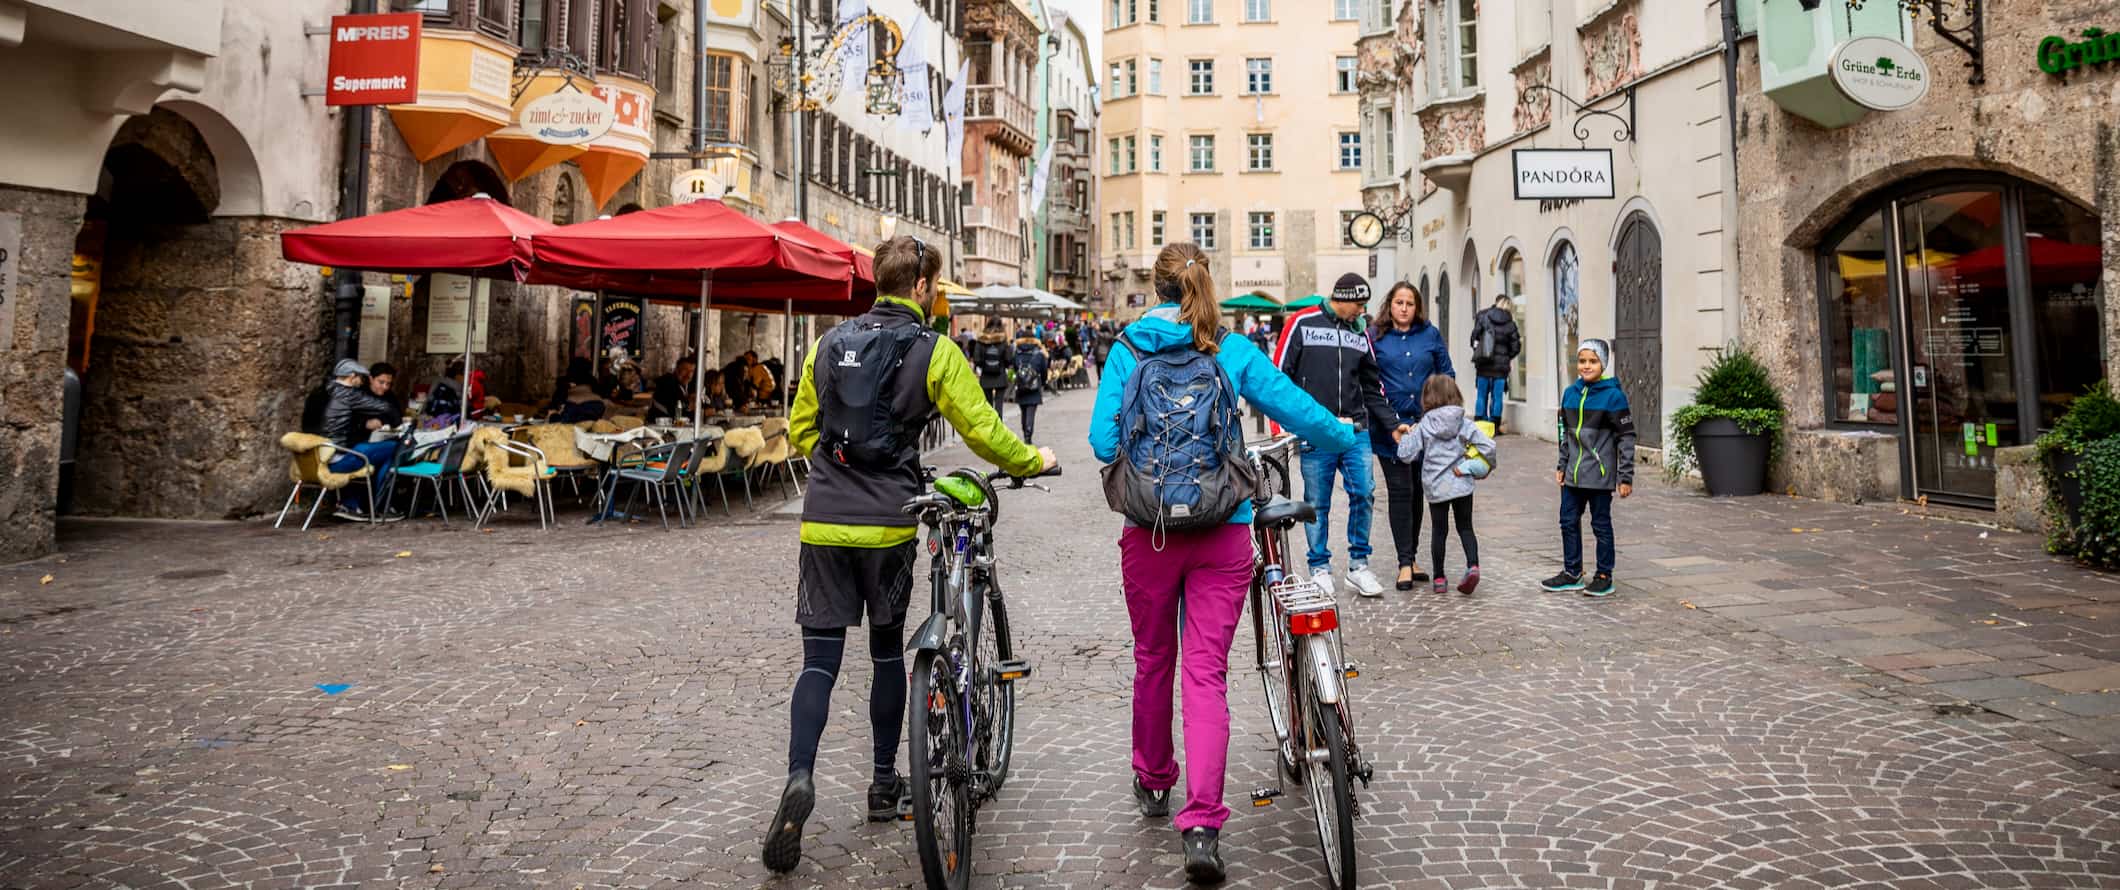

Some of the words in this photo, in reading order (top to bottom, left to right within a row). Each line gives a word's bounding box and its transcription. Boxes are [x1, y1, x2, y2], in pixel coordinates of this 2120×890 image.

[337, 25, 410, 42] MPREIS
[1842, 58, 1876, 74] Grüne
[1896, 66, 1921, 81] Erde
[333, 75, 407, 93] Supermarkt
[529, 107, 551, 125] zimt
[569, 107, 603, 125] zucker
[1522, 166, 1606, 184] PANDORA
[1305, 328, 1335, 341] Monte
[1344, 332, 1367, 347] Carlo
